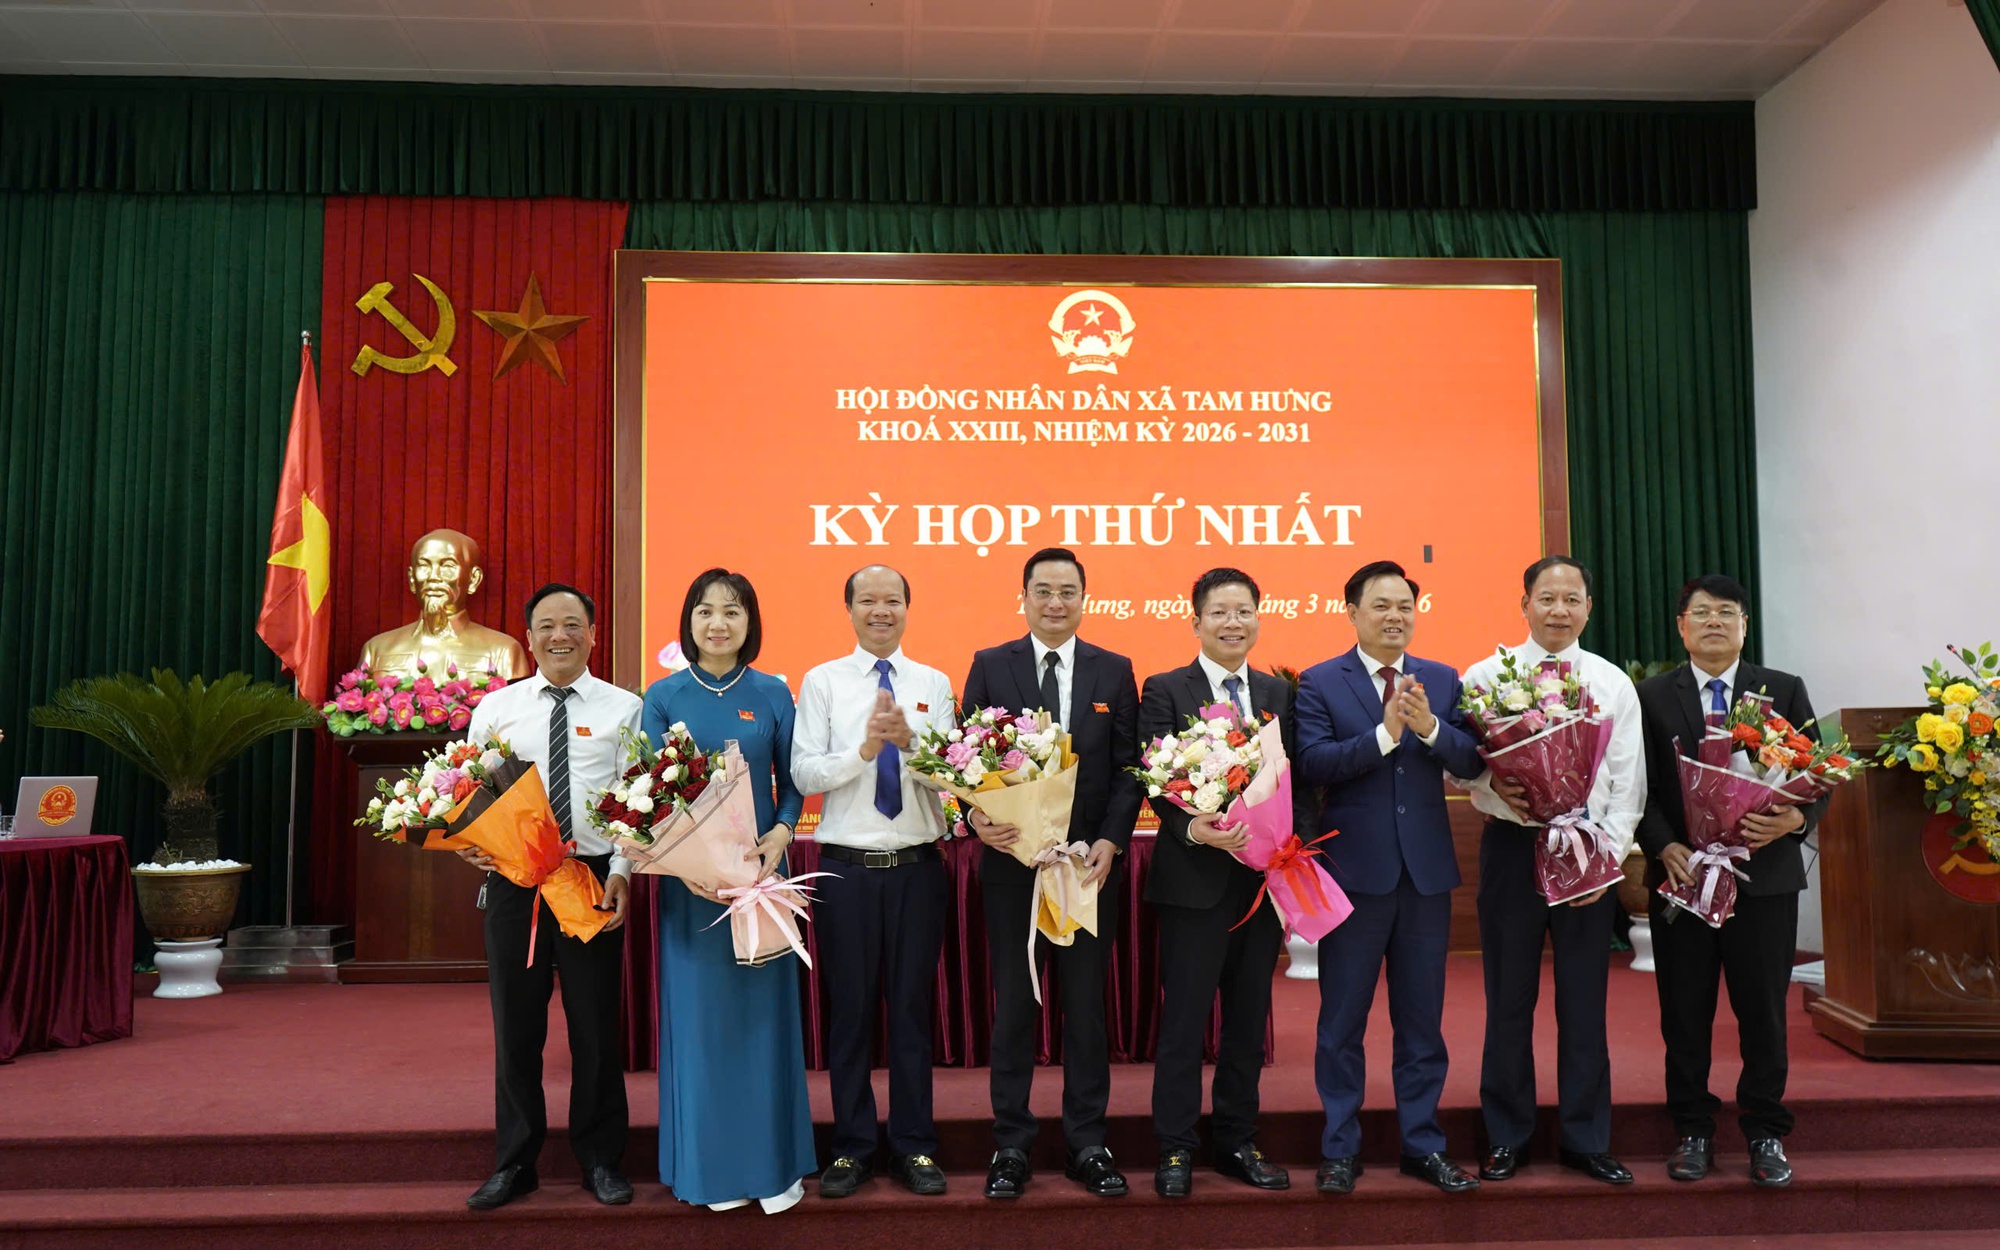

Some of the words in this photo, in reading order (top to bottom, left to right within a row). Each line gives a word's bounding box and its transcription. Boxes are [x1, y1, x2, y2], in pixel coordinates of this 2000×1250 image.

[836, 386, 890, 415] HỘI
[895, 384, 979, 412] ĐỒNG
[985, 383, 1065, 411] NHÂN
[1072, 383, 1131, 411] DÂN
[1137, 386, 1177, 411] XÃ
[1183, 390, 1244, 412] TAM
[1249, 388, 1332, 412] HƯNG
[857, 416, 942, 443] KHOÁ
[948, 420, 1027, 445] XXIII,
[1033, 417, 1129, 447] NHIỆM
[1135, 415, 1176, 443] KỲ
[1182, 421, 1237, 442] 2026
[1258, 421, 1310, 443] 2031
[809, 491, 900, 546] KỲ
[912, 503, 1041, 557] HỌP
[1050, 492, 1186, 546] THỨ
[1194, 491, 1362, 546] NHẤT
[1143, 593, 1195, 620] ngày
[1256, 592, 1300, 621] áng
[1305, 592, 1319, 614] 3
